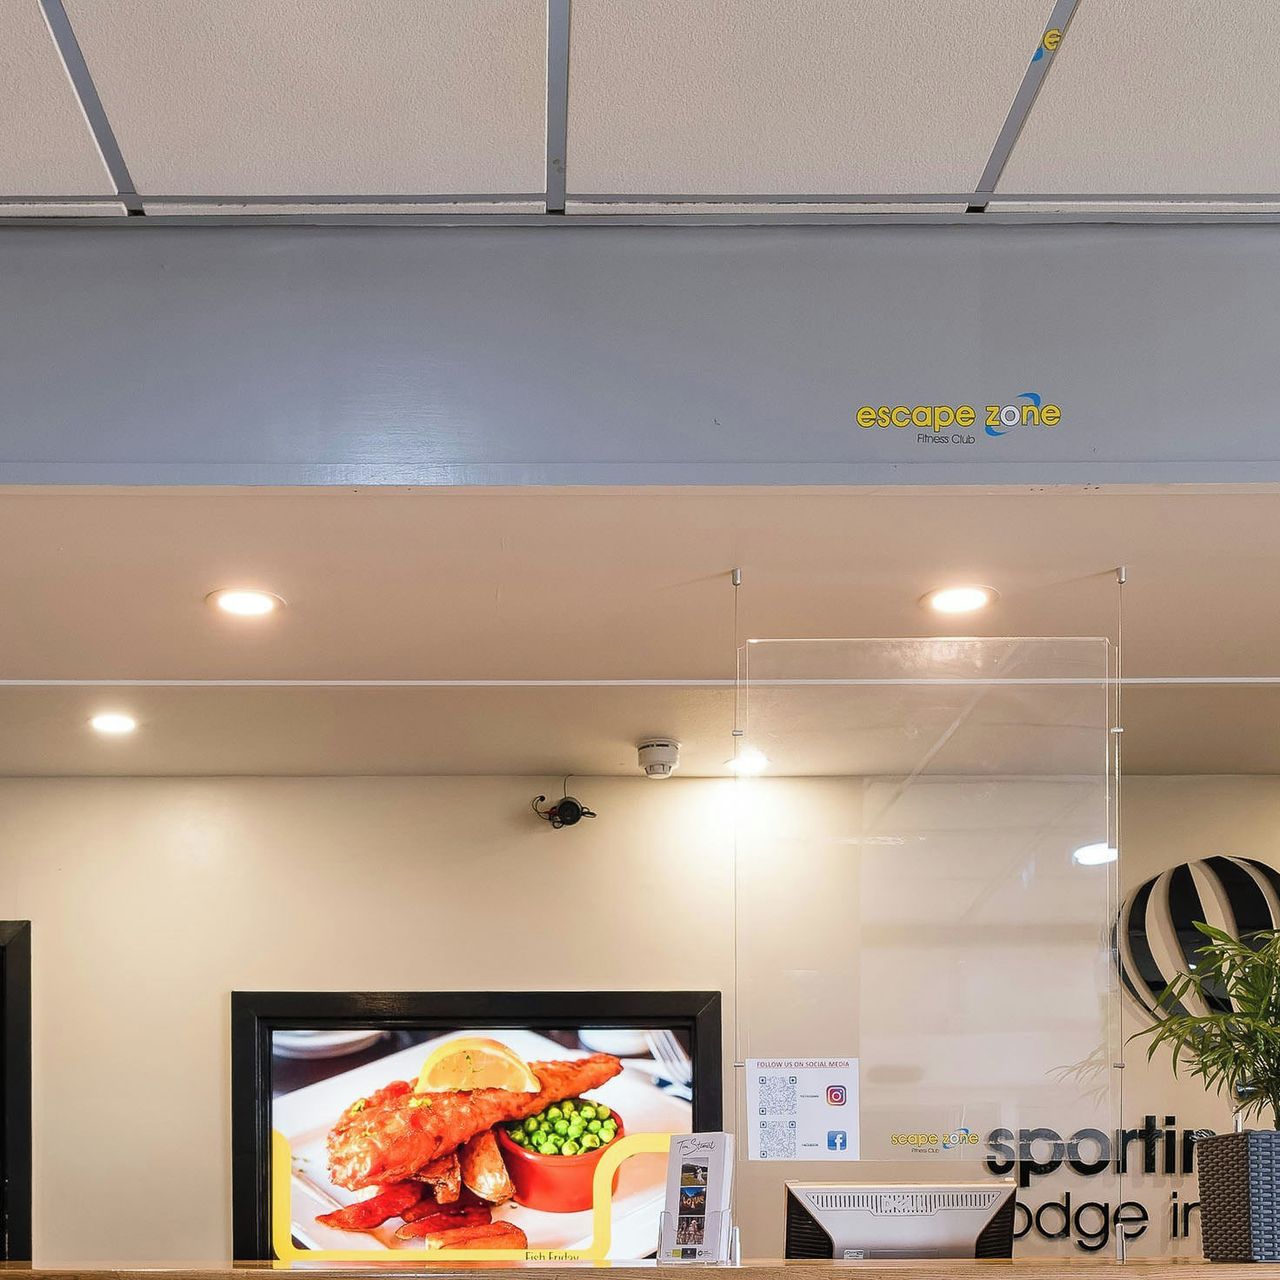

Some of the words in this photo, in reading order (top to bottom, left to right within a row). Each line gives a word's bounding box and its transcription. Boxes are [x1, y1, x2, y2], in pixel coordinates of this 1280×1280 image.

[855, 405, 977, 433] escape
[985, 404, 1062, 426] zone
[916, 433, 950, 444] Fitness
[951, 433, 976, 445] Club
[756, 1061, 783, 1069] FOLLOW
[784, 1061, 793, 1069] US
[794, 1061, 805, 1069] ON
[805, 1061, 827, 1069] SOCIAL
[828, 1061, 850, 1069] MEDIA
[942, 1133, 980, 1145] zone
